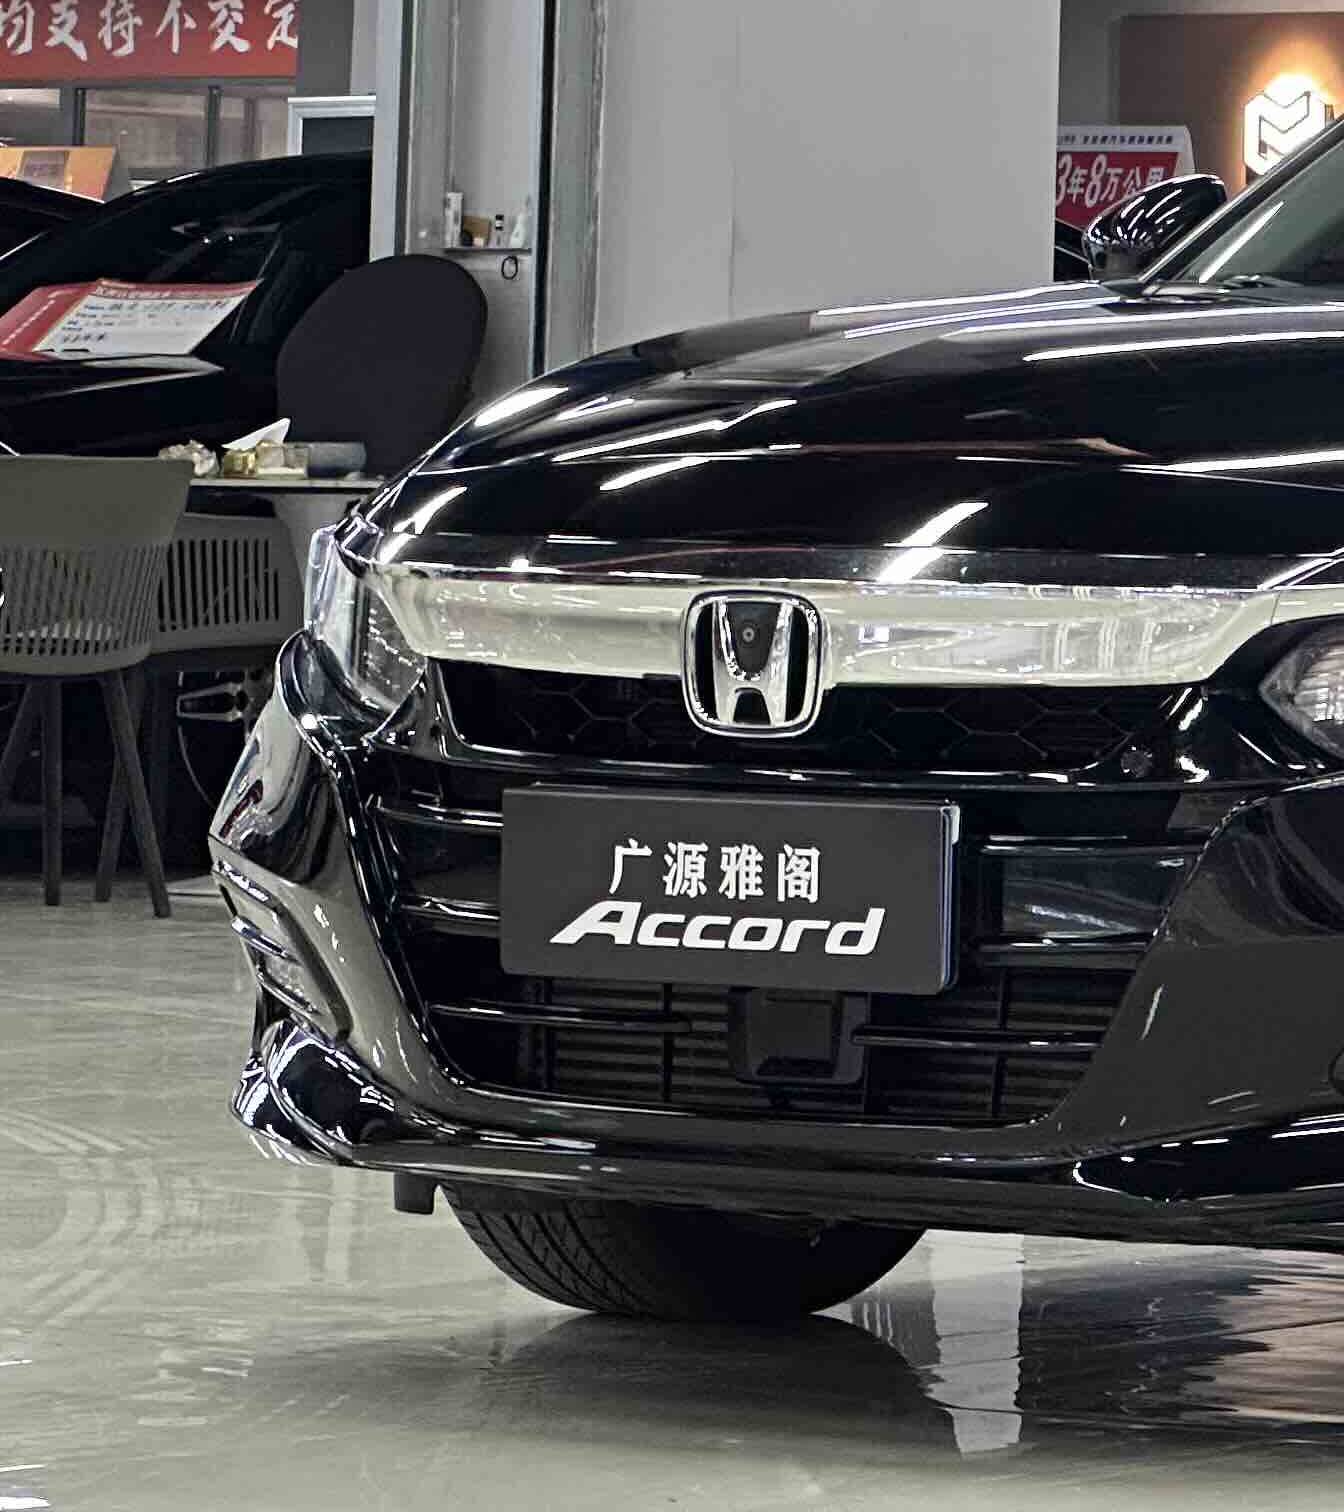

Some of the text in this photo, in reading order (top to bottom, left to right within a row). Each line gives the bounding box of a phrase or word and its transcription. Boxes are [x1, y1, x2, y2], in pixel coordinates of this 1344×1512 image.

[608, 838, 822, 904] 广源雅阁
[549, 899, 886, 956] Accord
